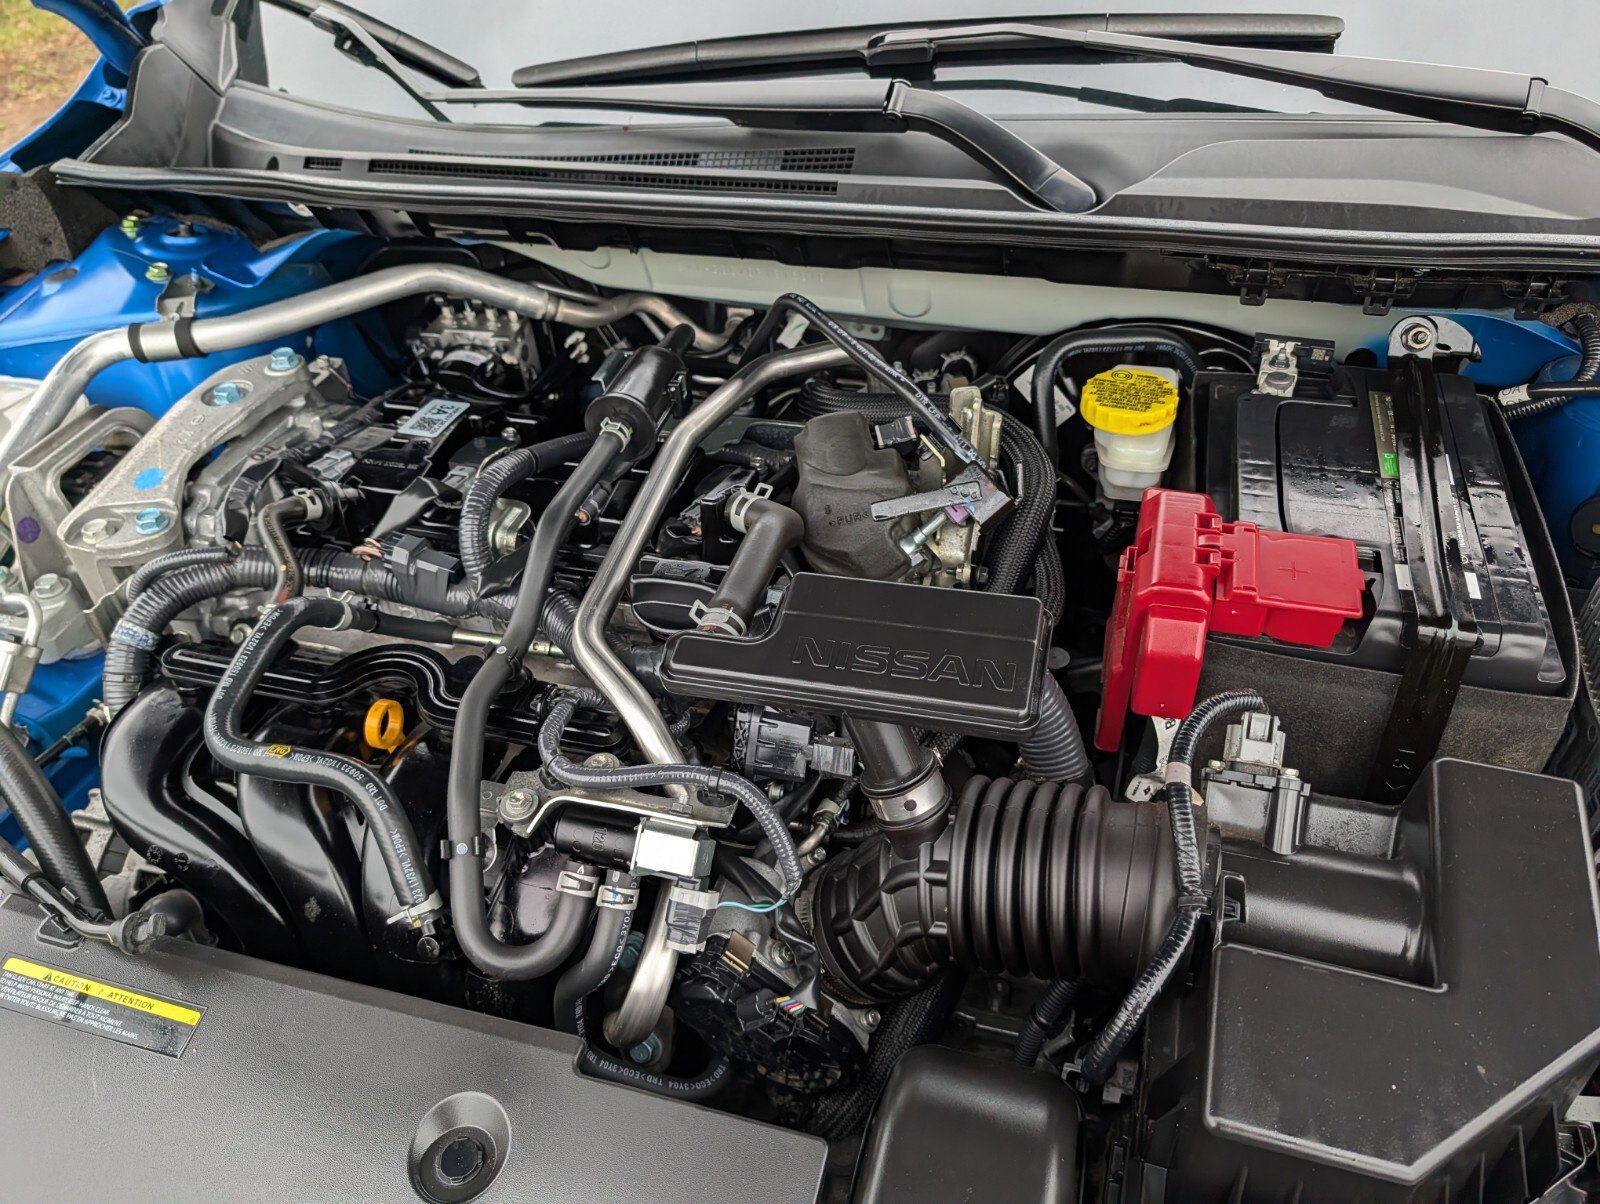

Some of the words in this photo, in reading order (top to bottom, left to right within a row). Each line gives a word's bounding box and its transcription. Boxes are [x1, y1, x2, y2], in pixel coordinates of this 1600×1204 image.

[791, 636, 1017, 692] NISSAN
[54, 975, 91, 992] CAUTION
[107, 991, 154, 1010] ATTENTION
